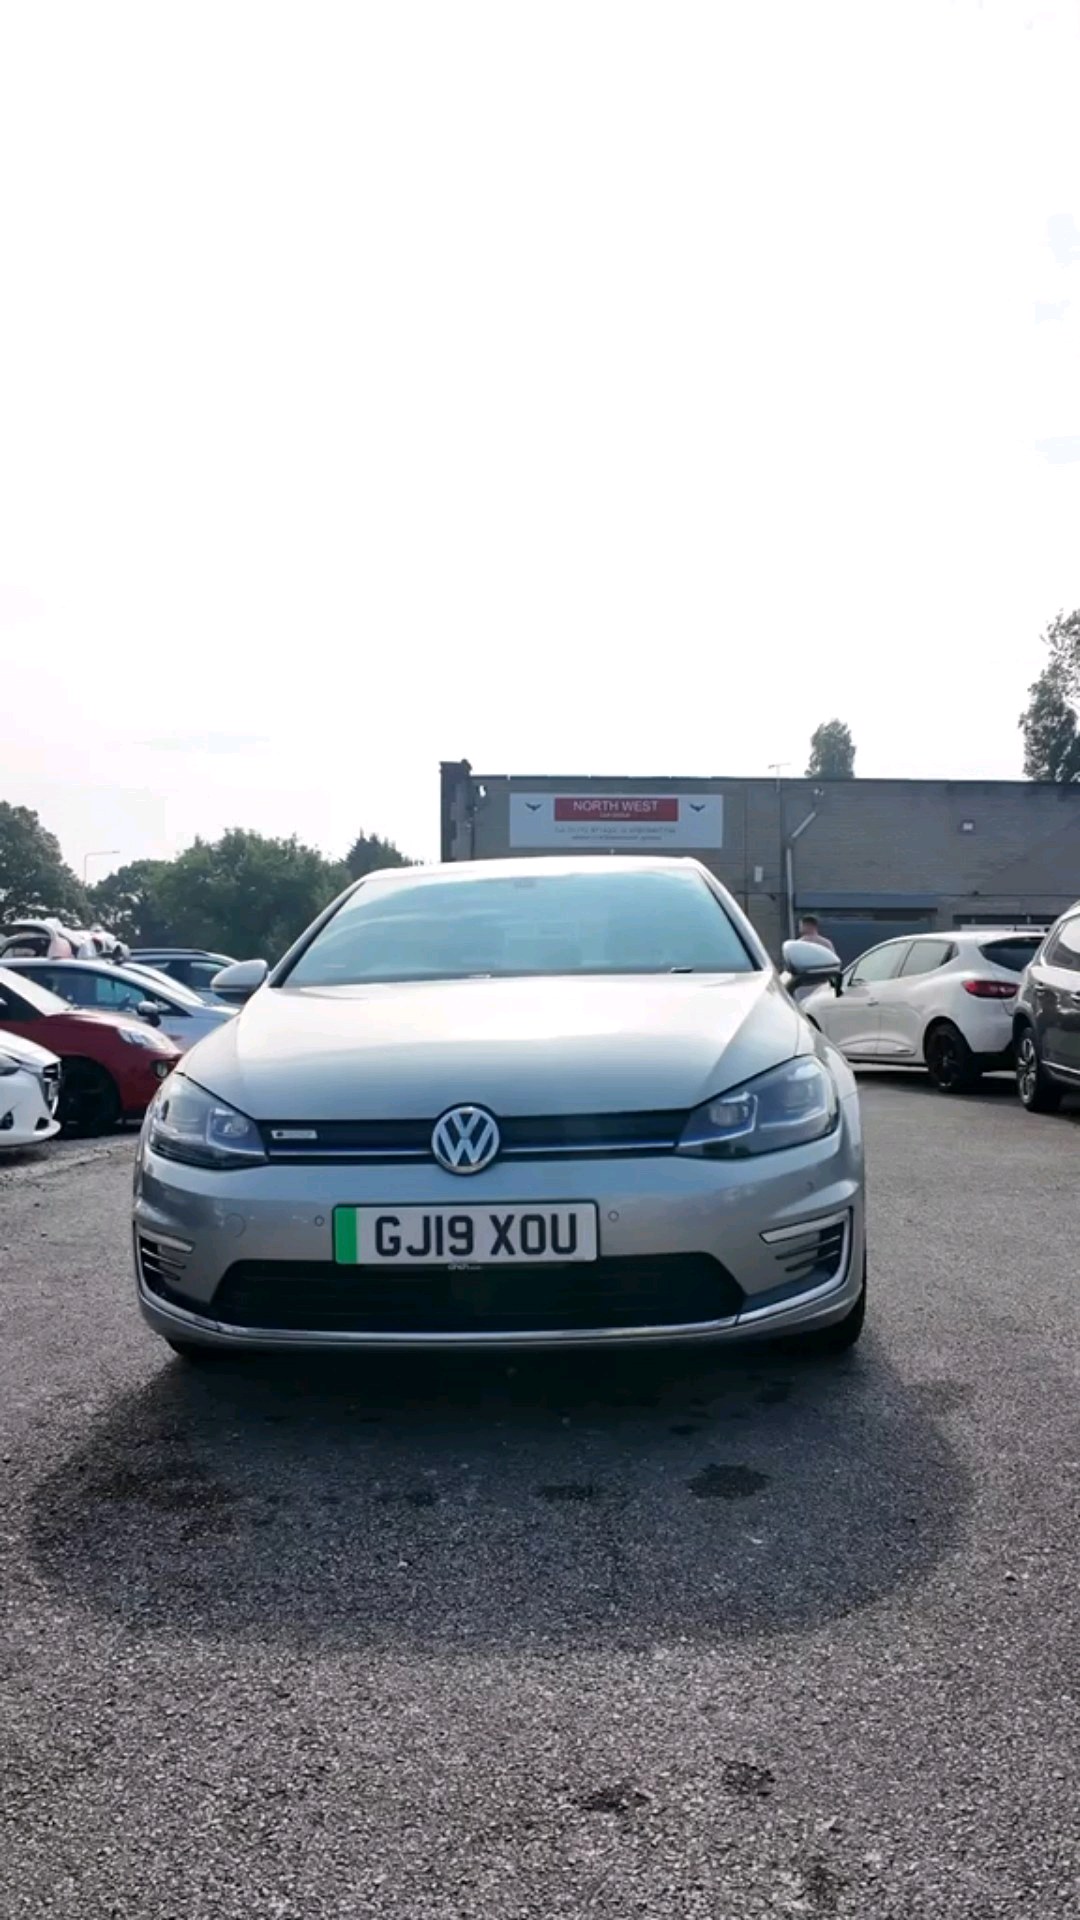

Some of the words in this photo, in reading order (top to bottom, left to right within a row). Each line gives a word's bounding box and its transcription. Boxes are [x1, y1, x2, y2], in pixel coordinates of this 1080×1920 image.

[572, 800, 619, 812] NORTH
[622, 800, 658, 812] WEST
[375, 1214, 474, 1257] GJ19
[489, 1212, 577, 1256] XOU
